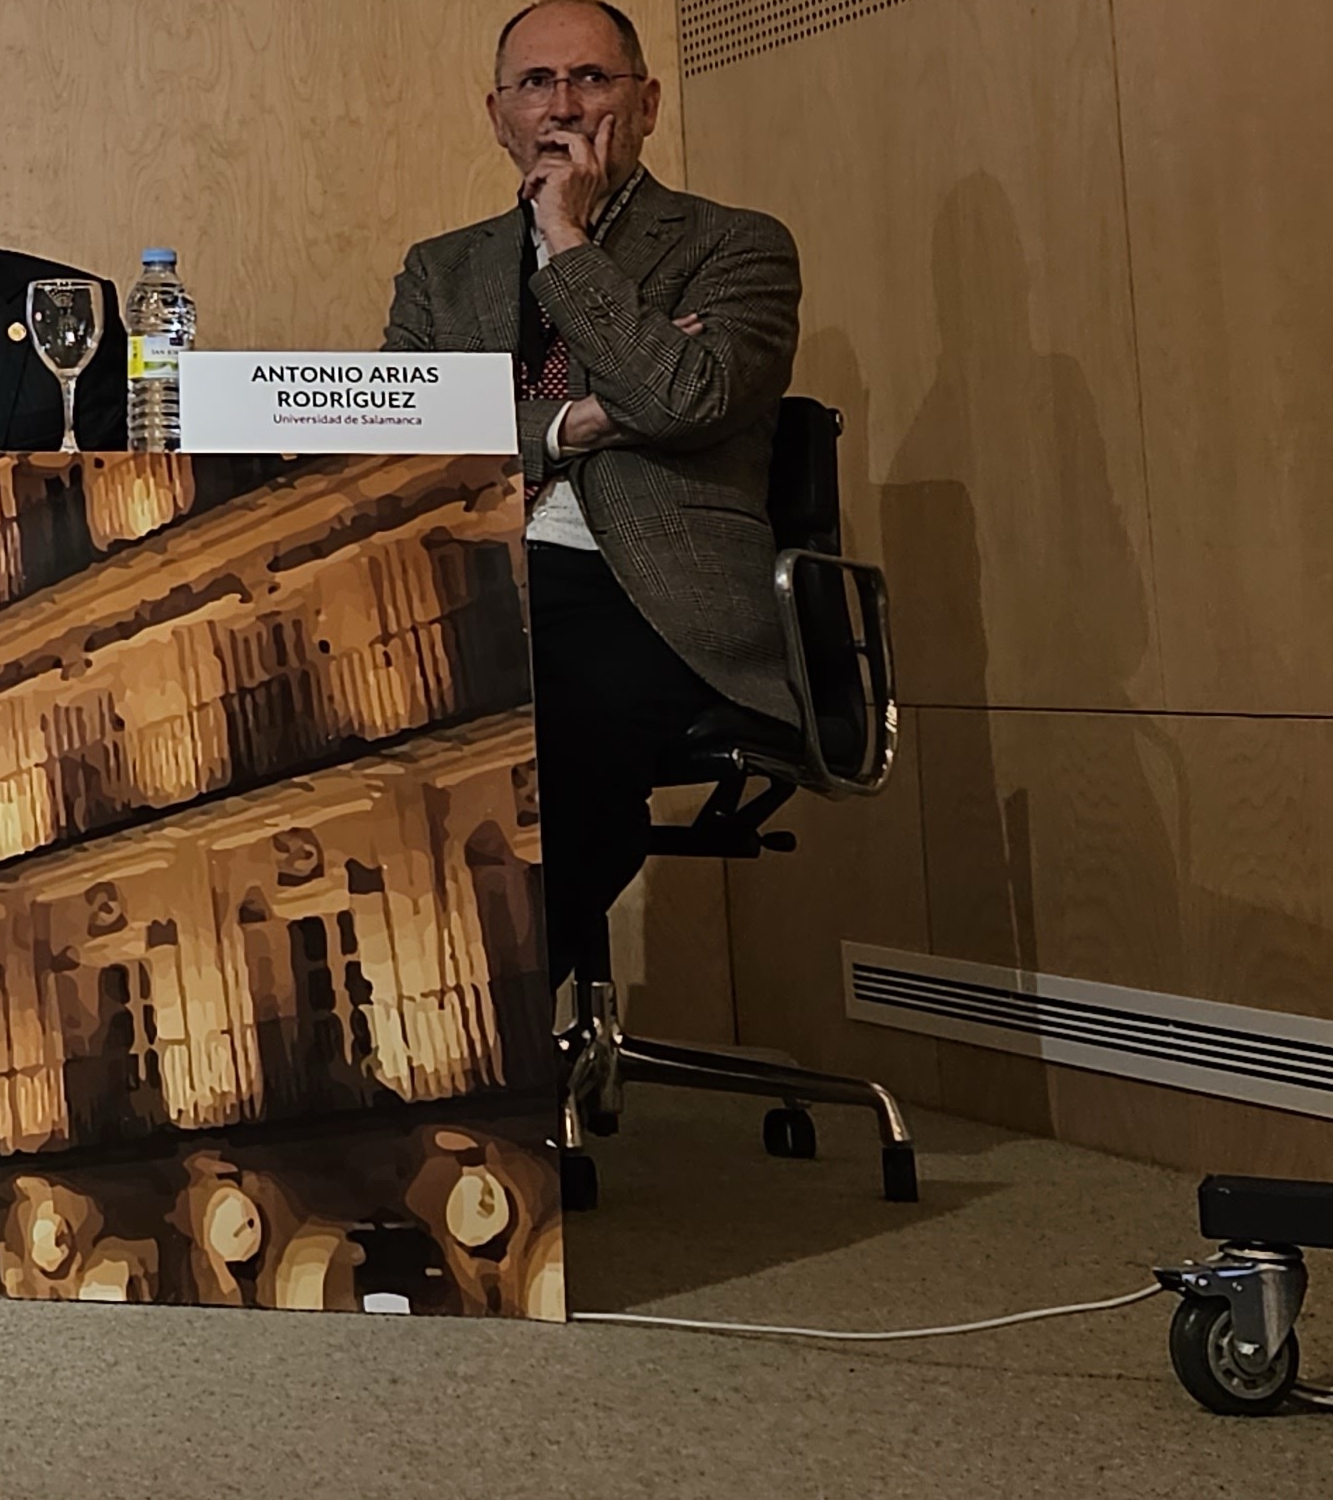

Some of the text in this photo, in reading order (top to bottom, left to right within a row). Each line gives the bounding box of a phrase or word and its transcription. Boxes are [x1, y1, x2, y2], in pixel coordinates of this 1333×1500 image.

[251, 366, 439, 384] ANTONIO ARIAS
[277, 388, 416, 409] RODRÍGUEZ
[273, 414, 422, 426] Universidad de Salamanca
